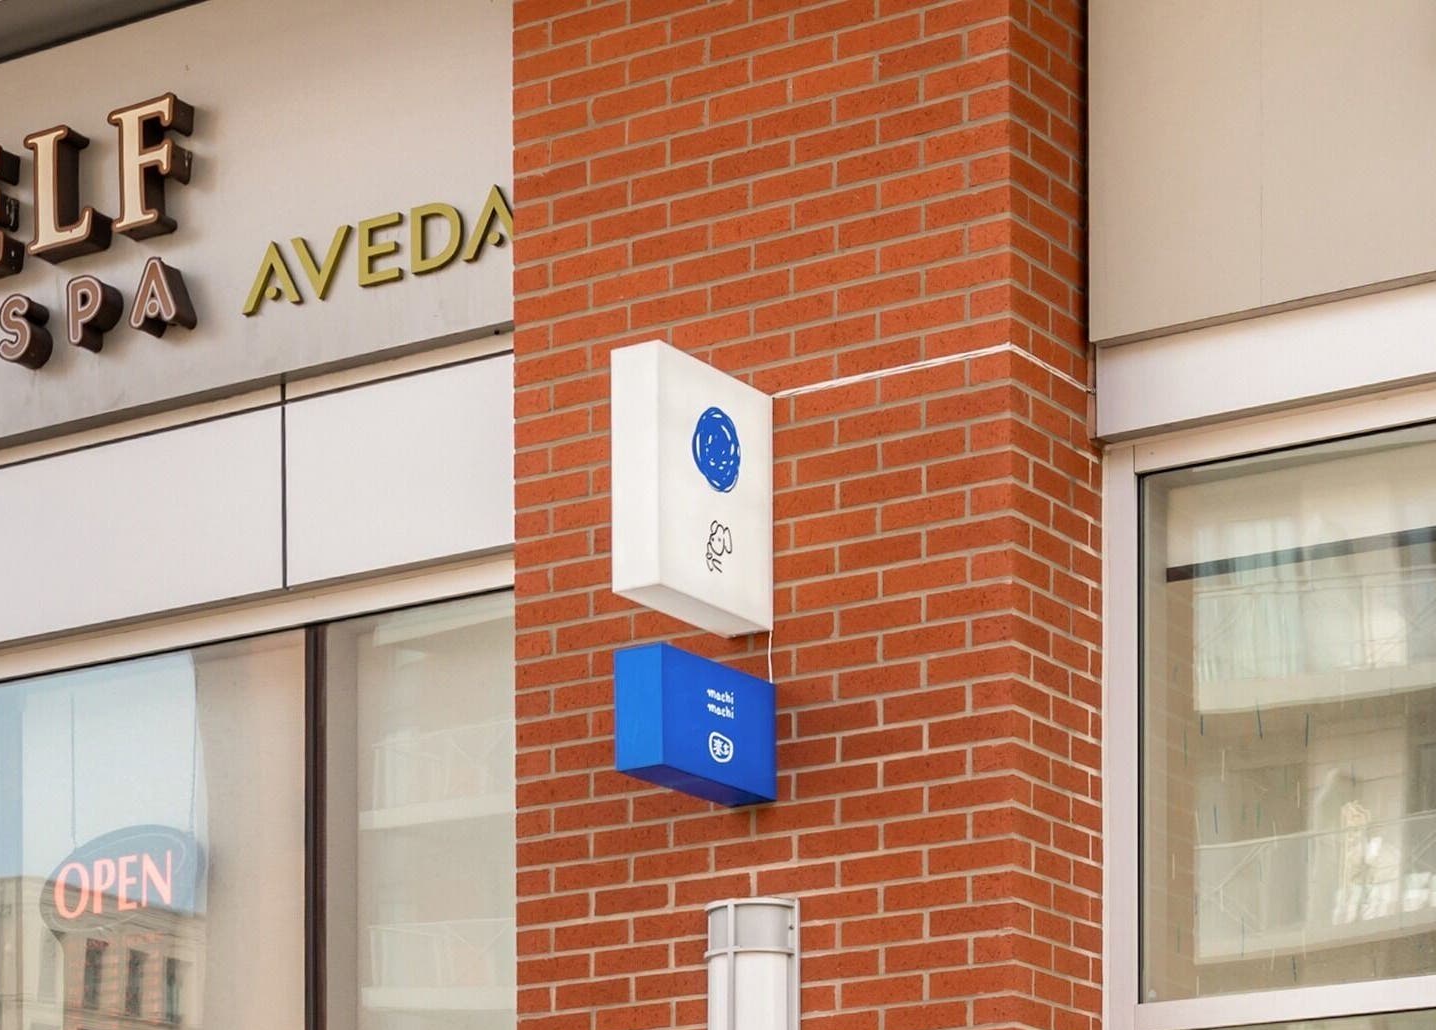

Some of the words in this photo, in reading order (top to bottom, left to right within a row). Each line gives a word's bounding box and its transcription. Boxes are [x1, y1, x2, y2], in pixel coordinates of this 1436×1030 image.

[242, 184, 513, 317] AVEDA
[707, 688, 734, 705] machi
[707, 703, 734, 719] machi
[54, 850, 172, 919] OPEN
